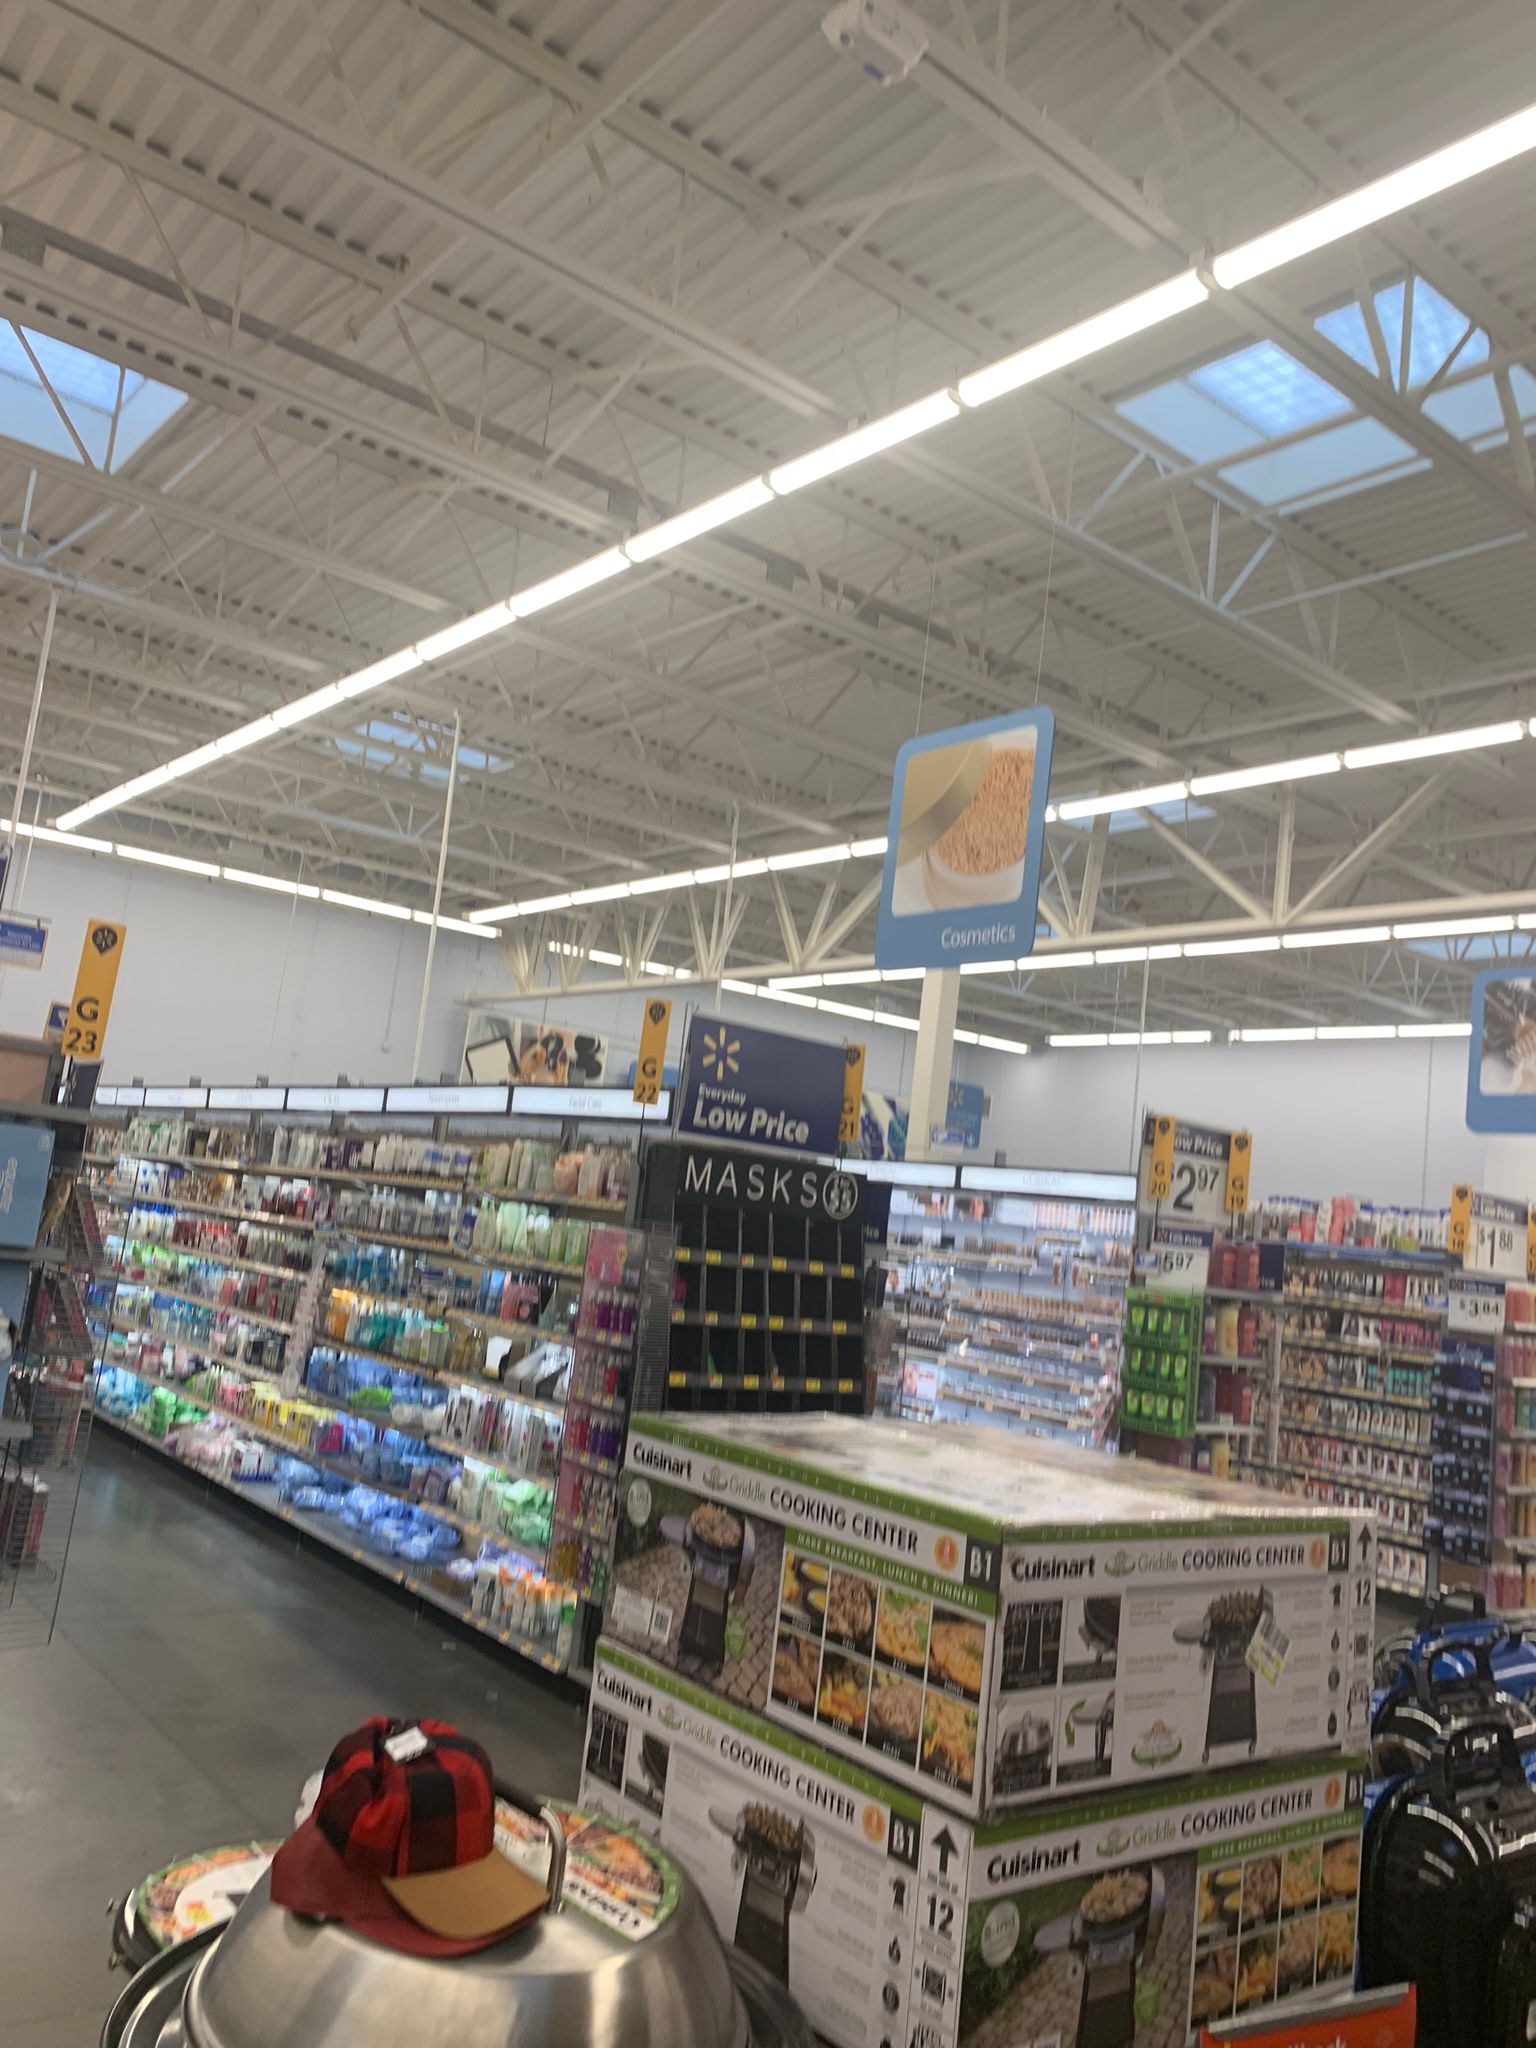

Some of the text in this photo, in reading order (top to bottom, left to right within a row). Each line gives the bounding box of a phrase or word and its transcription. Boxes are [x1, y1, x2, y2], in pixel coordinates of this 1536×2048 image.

[941, 922, 1016, 949] Cosmetics
[76, 997, 99, 1022] G
[65, 1026, 97, 1053] 23
[699, 1083, 746, 1107] Everyday
[693, 1097, 809, 1145] Low Price
[1194, 1135, 1223, 1158] Price
[684, 1154, 818, 1208] MASKS
[633, 1441, 692, 1481] Cuisinart
[729, 1472, 767, 1504] Griddle
[770, 1485, 846, 1531] COOKING
[852, 1512, 918, 1555] CENTER
[969, 1546, 993, 1583] B1
[797, 1534, 821, 1552] MAKE
[882, 1560, 918, 1586] LUNCH
[1011, 1539, 1347, 1582] Cuisinart Griddle COOKING CENTER B1
[1356, 1577, 1371, 1606] 12
[597, 1668, 653, 1717] Cuisinart
[682, 1717, 717, 1748] Griddle
[720, 1734, 790, 1789] COOKING
[796, 1773, 856, 1823] CENTER
[892, 1819, 915, 1861] B1
[987, 1838, 1081, 1885] Cuisinart
[1132, 1818, 1177, 1848] Griddle
[1181, 1800, 1256, 1838] COOKING
[1261, 1788, 1313, 1821] CENTER
[927, 1893, 954, 1938] 12
